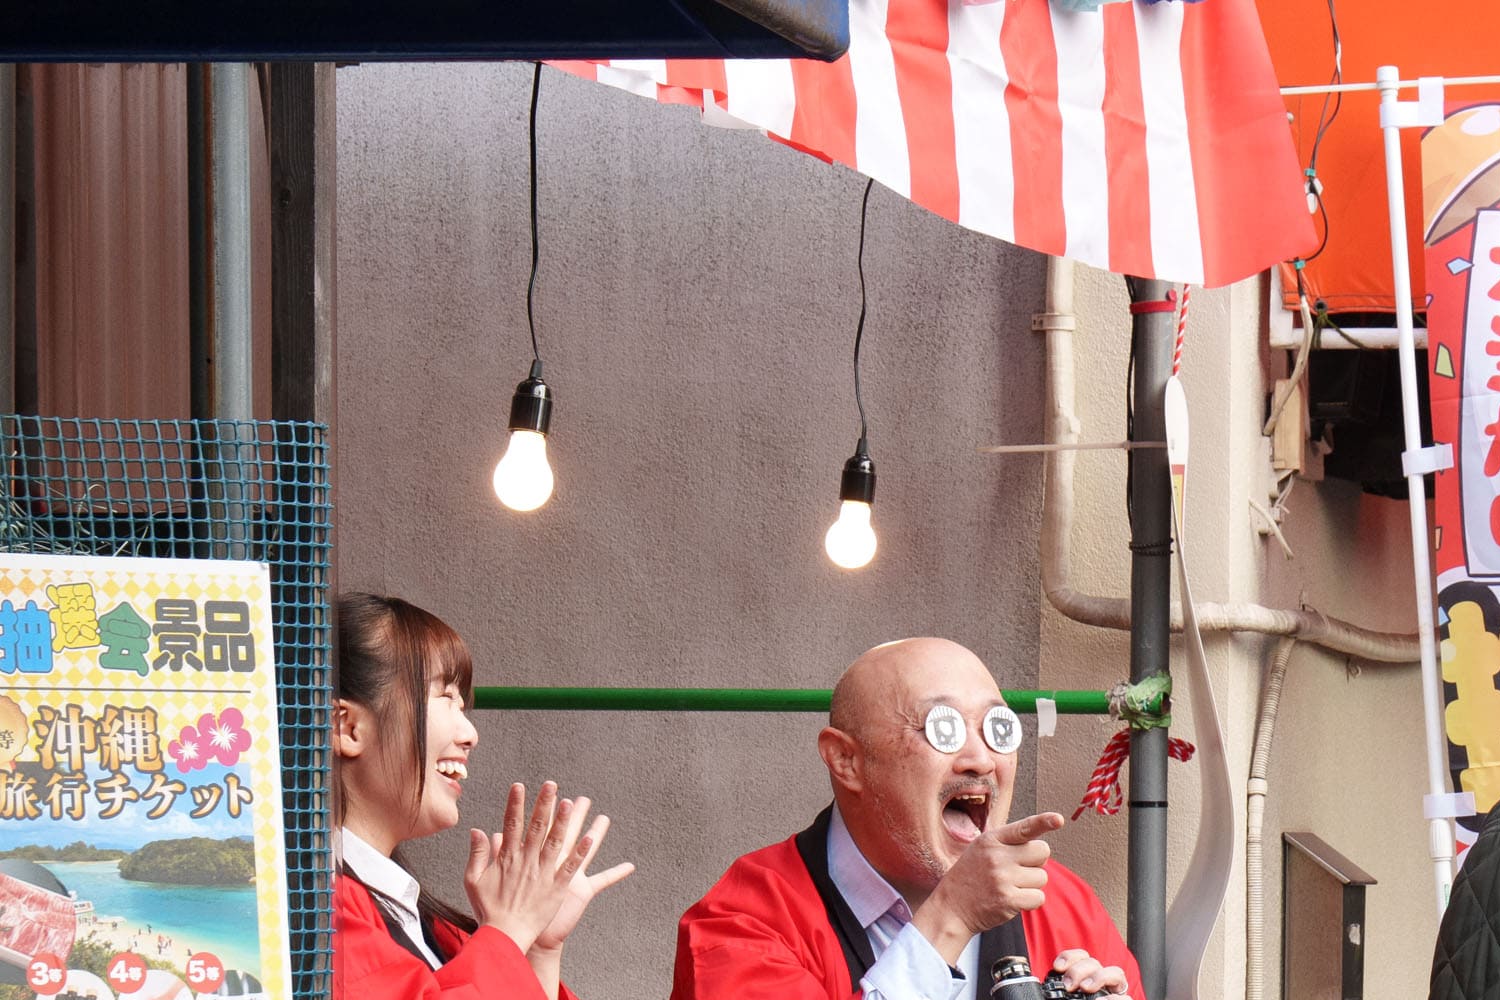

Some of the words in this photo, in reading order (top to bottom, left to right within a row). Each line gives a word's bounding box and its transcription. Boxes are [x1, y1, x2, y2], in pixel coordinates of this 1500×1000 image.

[0, 583, 256, 676] 抽選会景品
[34, 703, 164, 773] 沖縄
[0, 771, 253, 821] 旅行チケット
